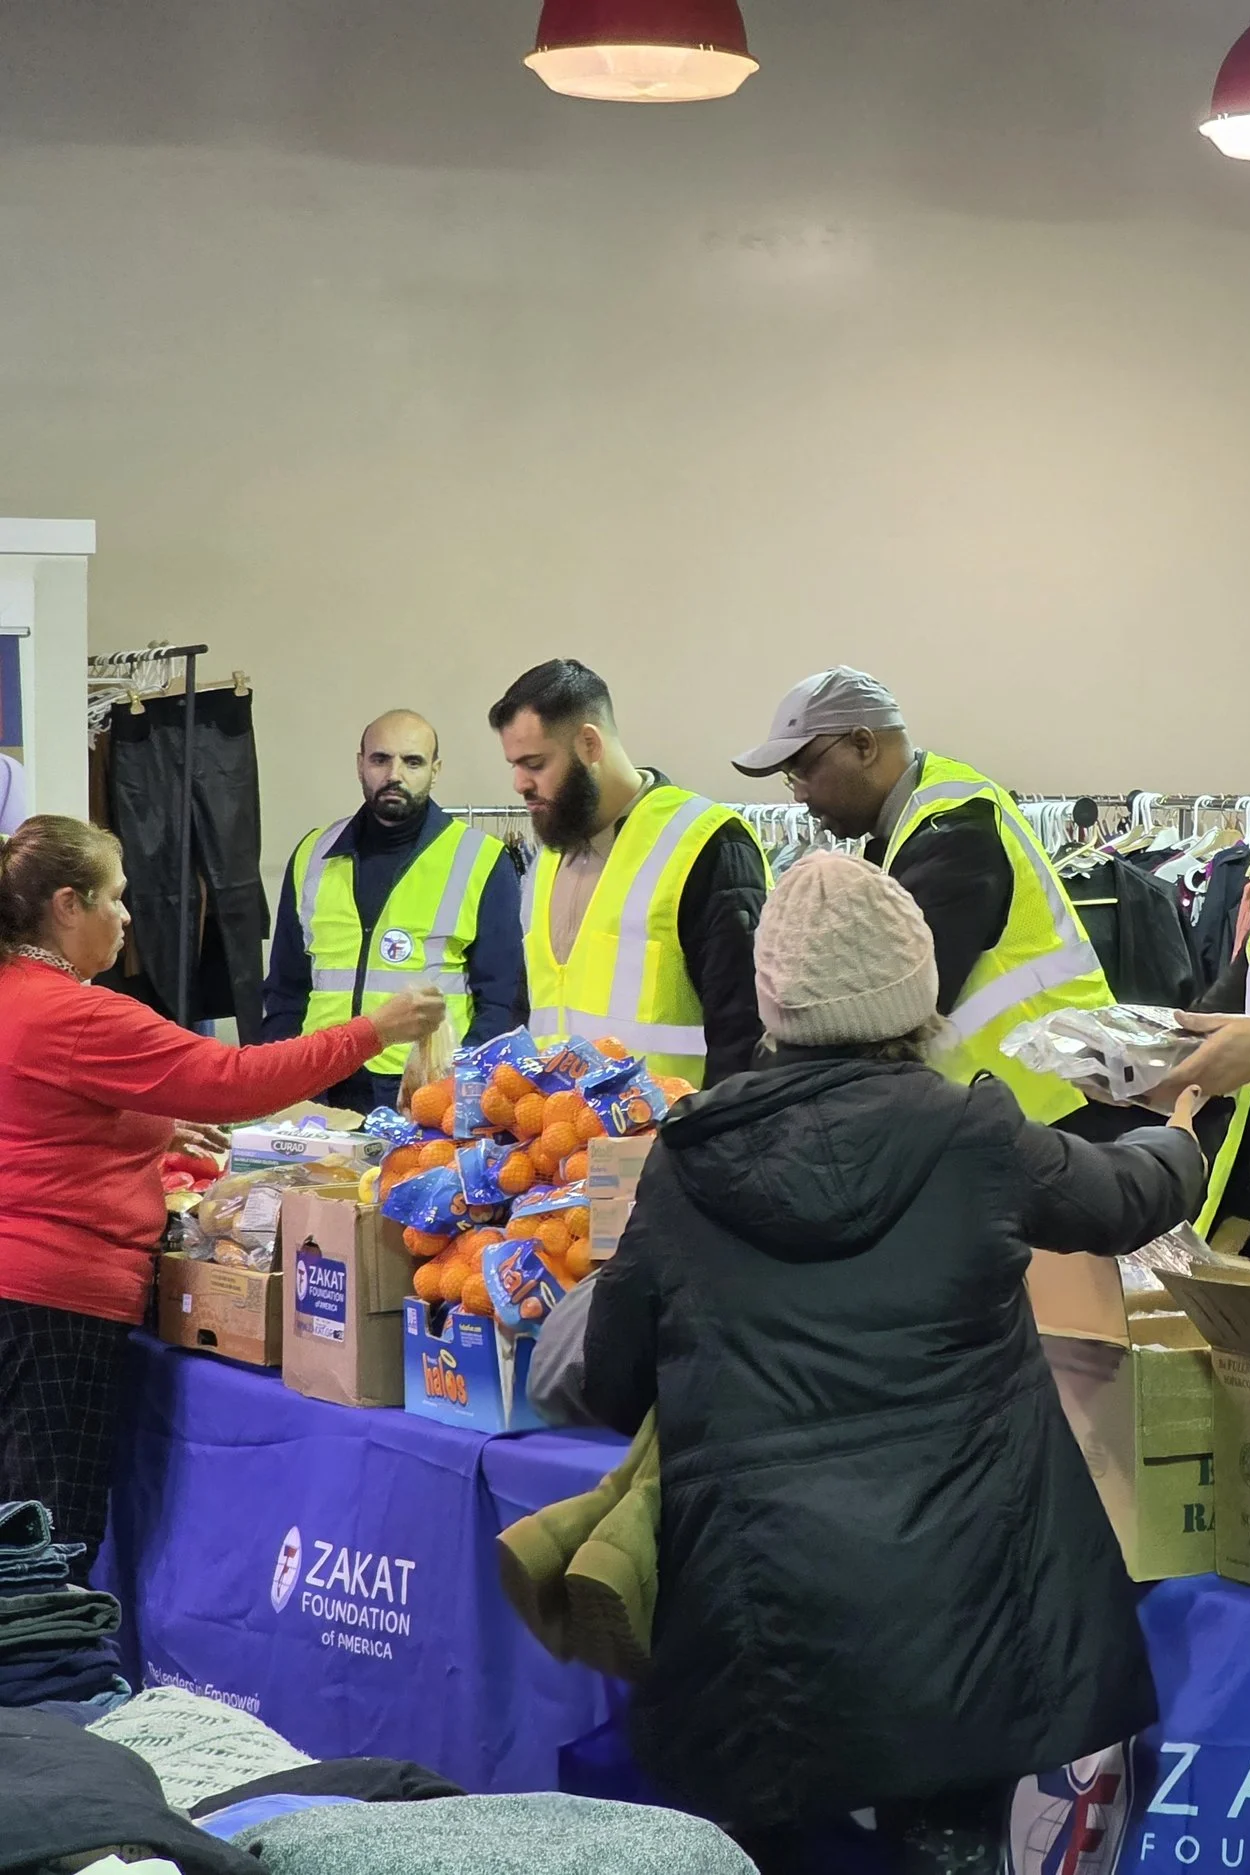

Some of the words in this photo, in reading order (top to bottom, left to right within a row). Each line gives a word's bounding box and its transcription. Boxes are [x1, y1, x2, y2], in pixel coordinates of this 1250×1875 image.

[273, 1140, 306, 1153] CURAD
[309, 1265, 345, 1291] ZAKAT
[309, 1286, 344, 1302] FOUNDATION
[422, 1352, 468, 1407] halos
[305, 1540, 416, 1605] ZAKAT
[302, 1591, 411, 1636] FOUNDATION
[321, 1630, 335, 1646] of
[337, 1632, 393, 1660] AMERICA
